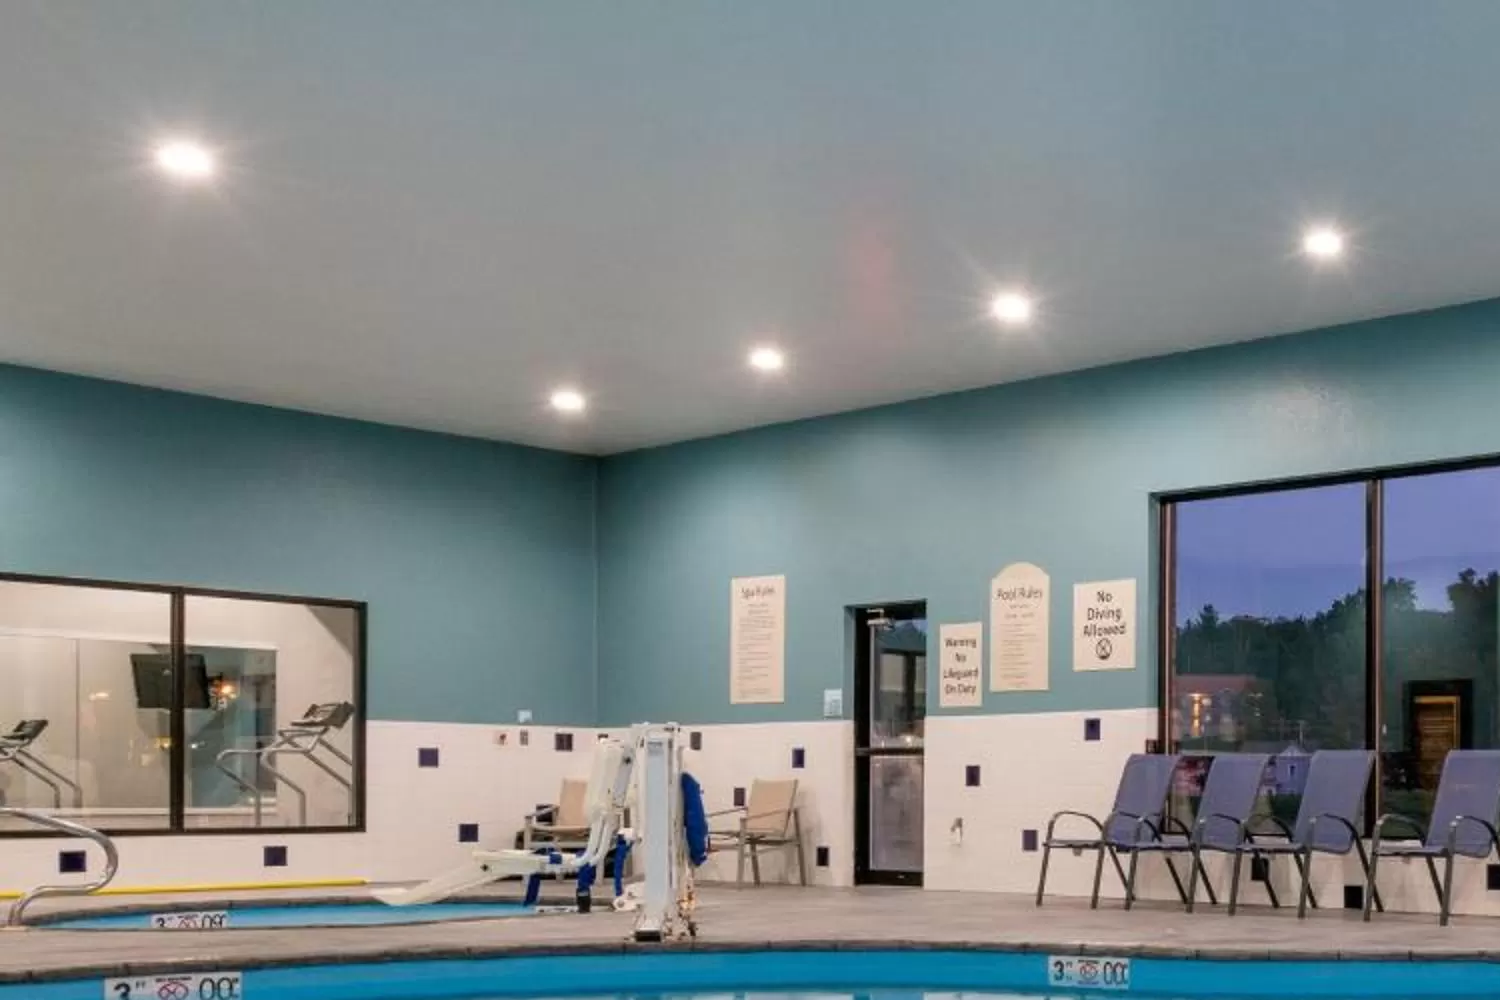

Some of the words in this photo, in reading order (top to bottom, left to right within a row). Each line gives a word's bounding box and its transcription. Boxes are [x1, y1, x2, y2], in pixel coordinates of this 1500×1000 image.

[996, 586, 1017, 601] Pool
[1017, 585, 1043, 599] Rules
[1096, 590, 1113, 603] No
[1087, 606, 1123, 623] Diving
[1083, 622, 1127, 638] Allowed
[944, 637, 977, 649] Warning
[955, 652, 967, 663] No
[943, 667, 979, 681] Lifeguard
[944, 683, 957, 695] On
[957, 682, 977, 697] Duty
